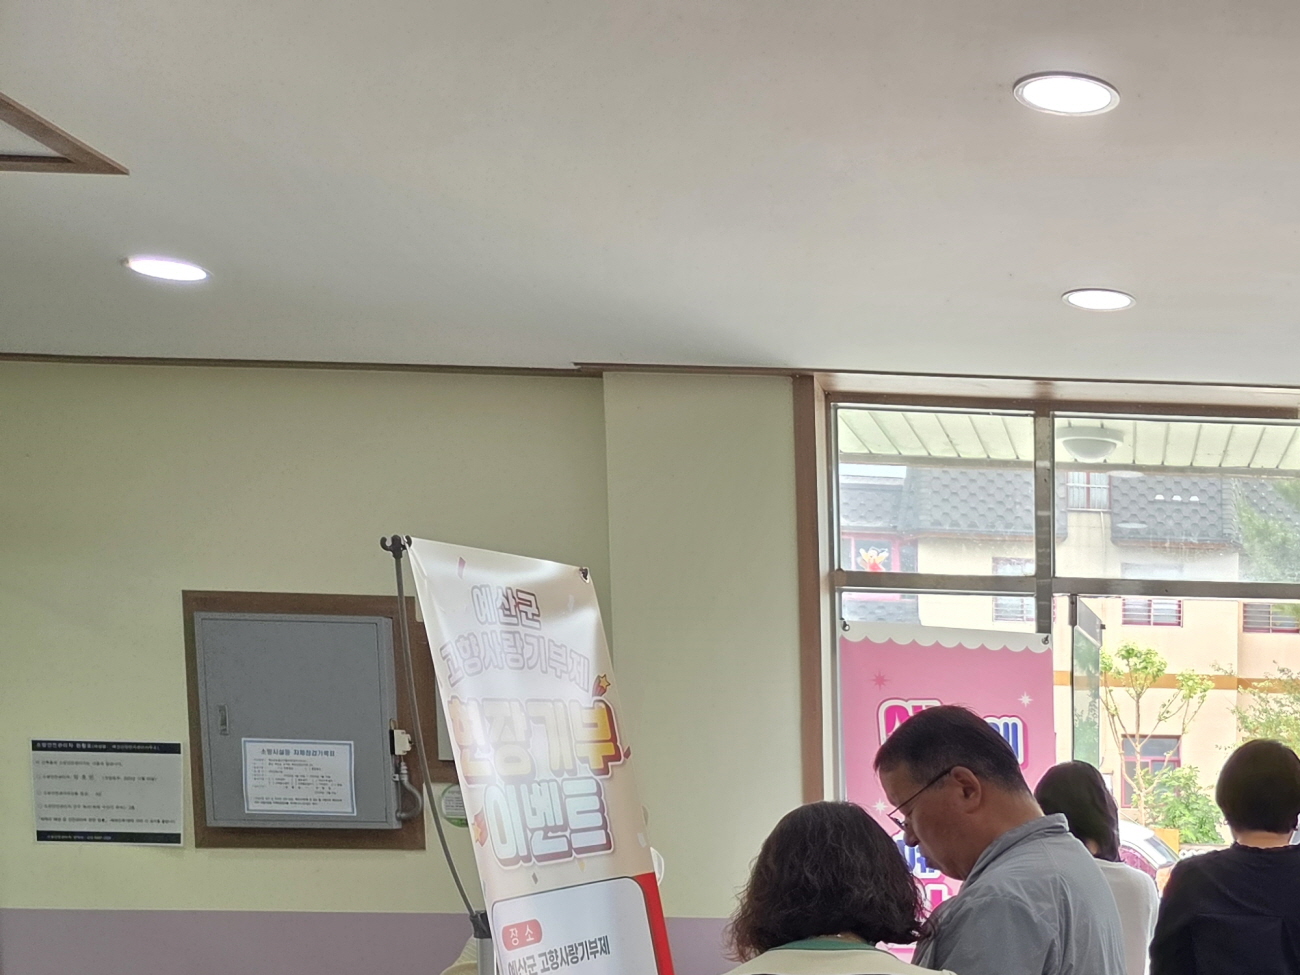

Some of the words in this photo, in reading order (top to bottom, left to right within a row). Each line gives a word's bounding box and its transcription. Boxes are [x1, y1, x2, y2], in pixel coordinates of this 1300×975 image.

[470, 584, 542, 631] 예산군
[440, 630, 590, 692] 고향사랑기부제
[449, 697, 622, 782] 현장기부
[484, 777, 613, 866] 이벤트
[538, 935, 610, 973] 고향사랑기부제
